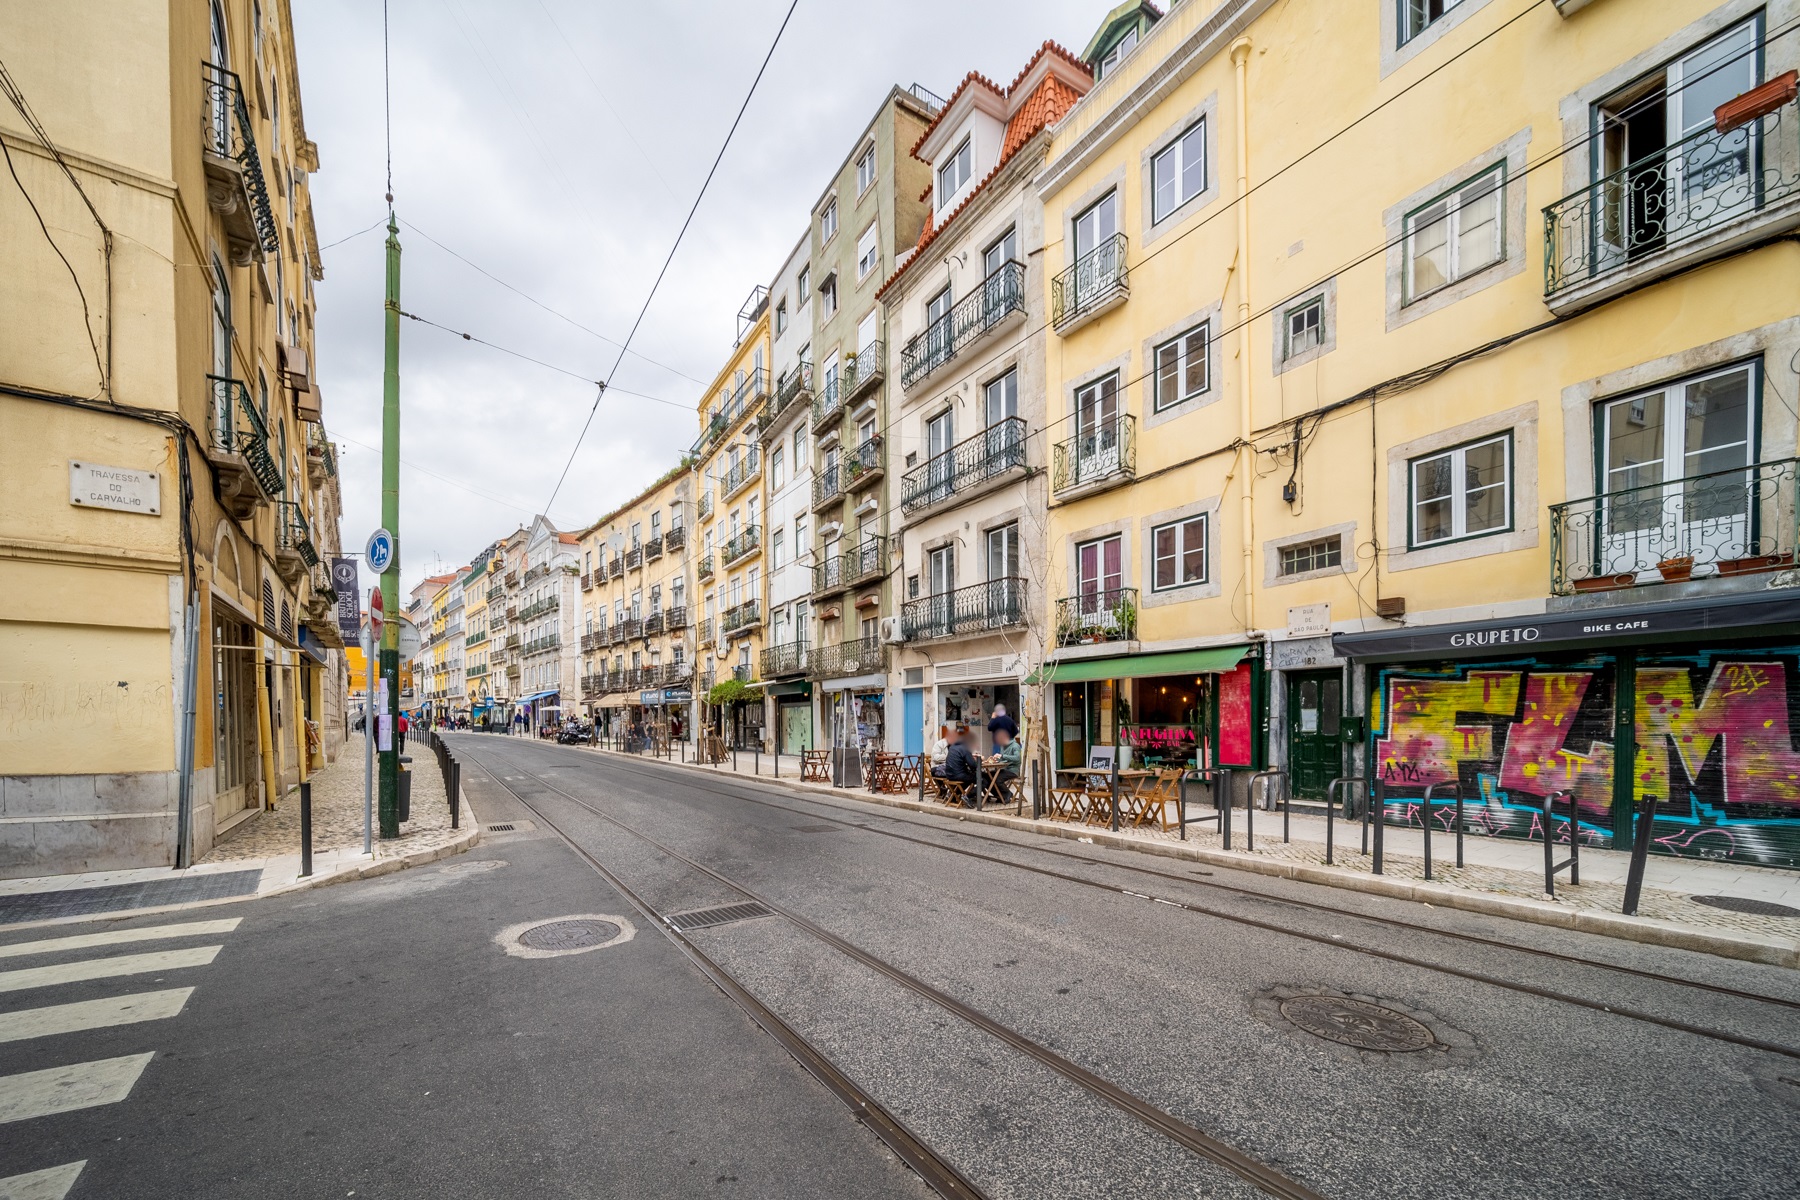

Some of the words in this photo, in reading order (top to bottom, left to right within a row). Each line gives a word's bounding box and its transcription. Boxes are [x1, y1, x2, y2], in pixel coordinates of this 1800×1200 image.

[90, 469, 140, 483] TRAVESSA
[109, 483, 122, 492] DO
[90, 492, 141, 506] CARVALHO
[338, 590, 346, 618] BRITISH
[345, 589, 354, 619] SCHOOL
[1450, 627, 1539, 647] GRUPETO
[1583, 623, 1612, 633] BIKE
[1615, 620, 1649, 630] CAFE
